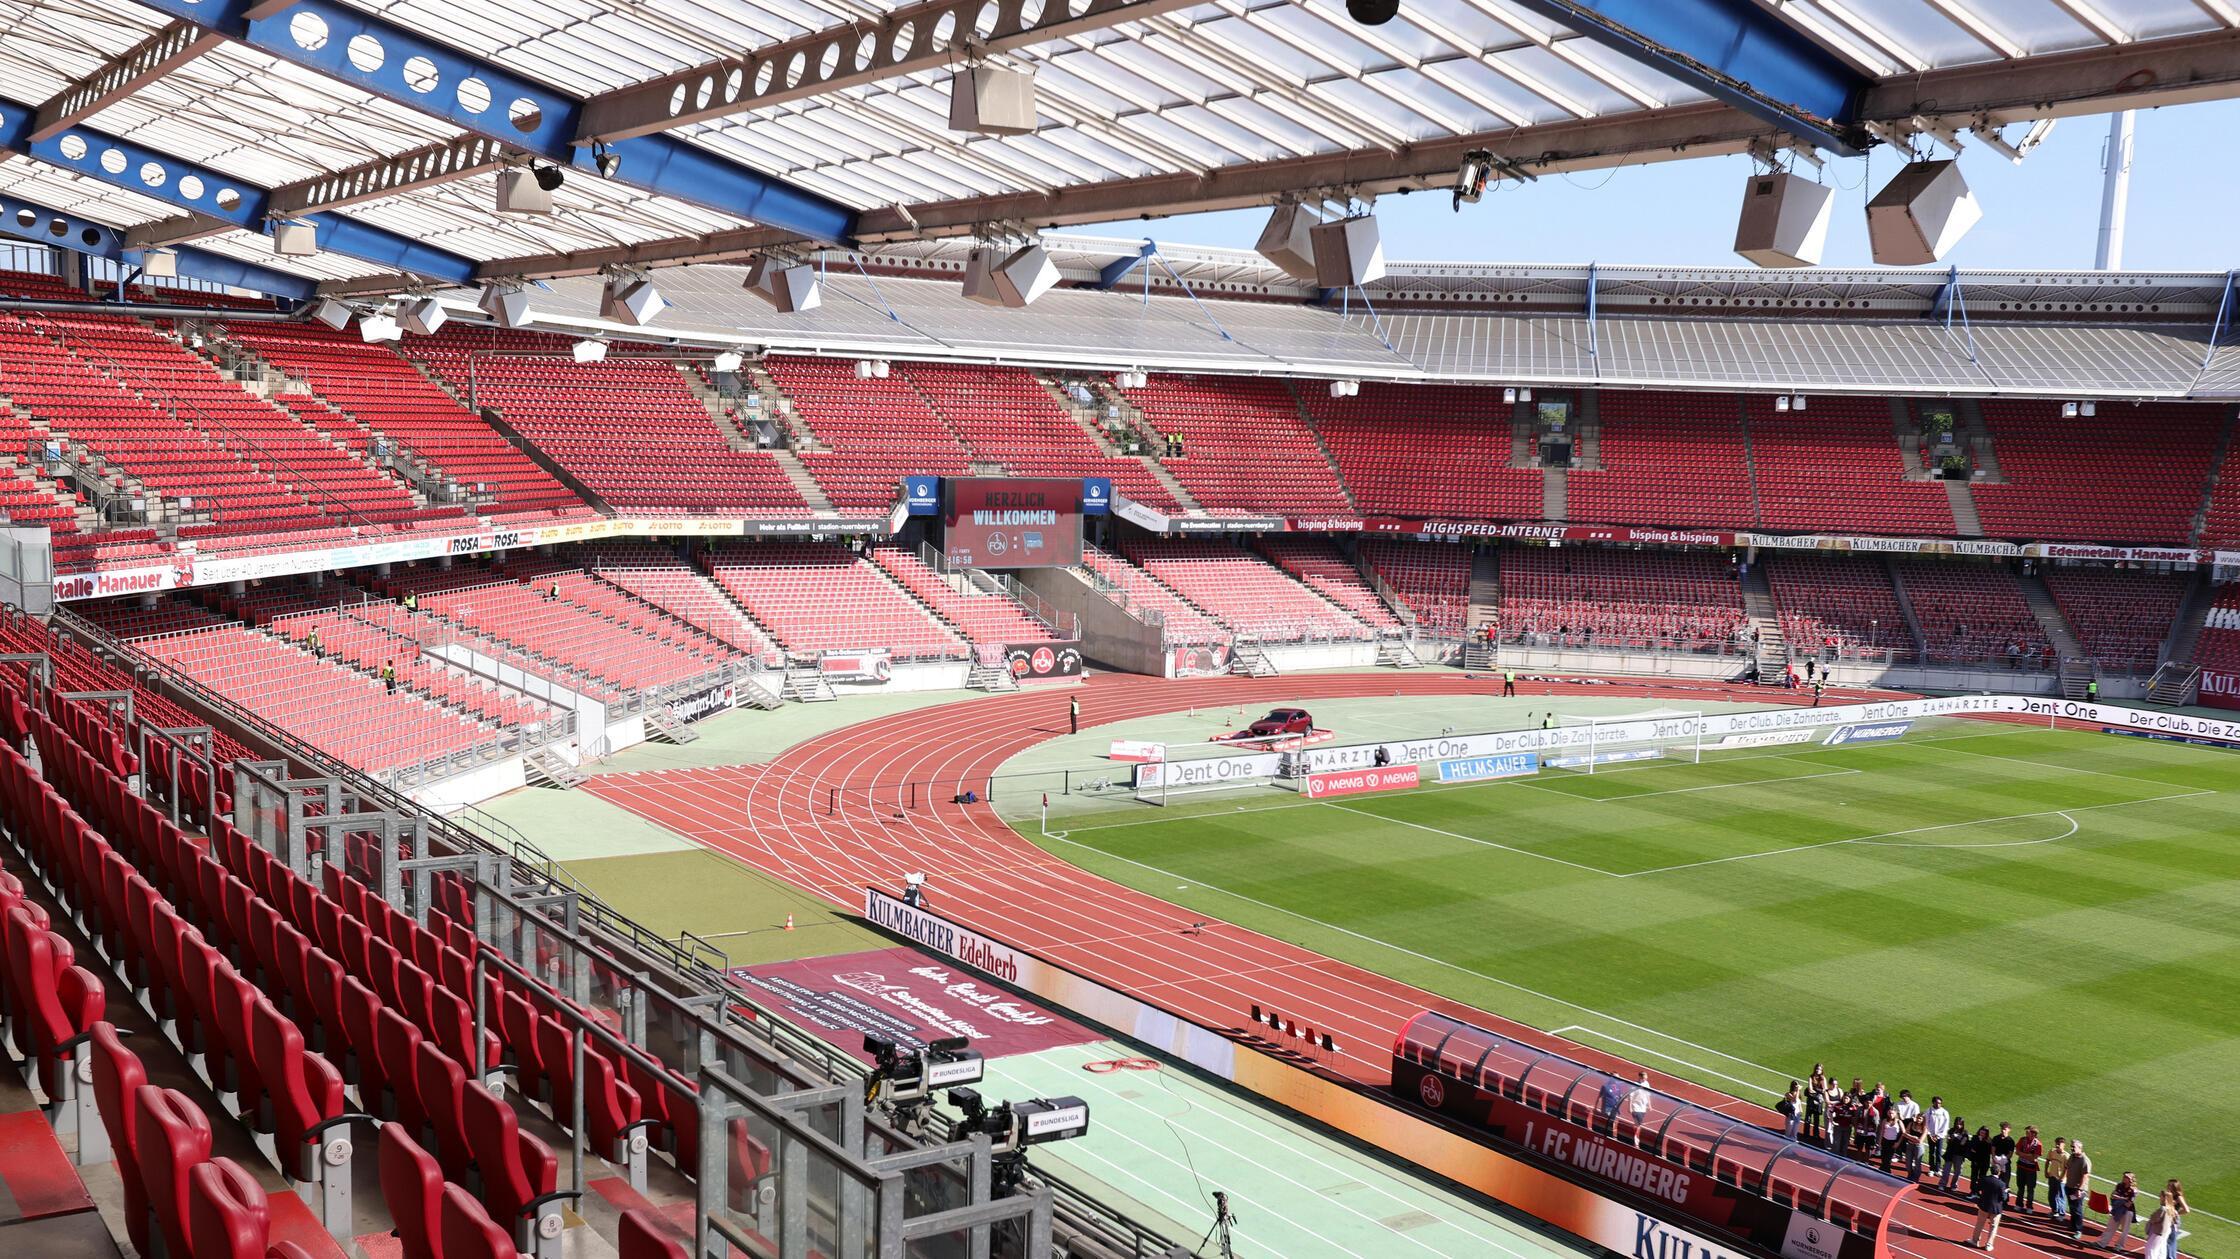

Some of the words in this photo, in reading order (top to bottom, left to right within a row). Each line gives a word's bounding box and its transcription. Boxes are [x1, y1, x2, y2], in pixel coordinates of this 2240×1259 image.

[985, 492, 1045, 507] HERZLICH
[973, 510, 1056, 525] WILLKOMMEN
[1298, 519, 1327, 531] bisping
[1335, 519, 1363, 531] bisping
[659, 522, 682, 530] LOTTO
[709, 522, 732, 530] LOTTO
[1422, 522, 1568, 538] HIGHSPEED-INTERNET
[494, 533, 519, 547] ROSA
[1630, 529, 1668, 542] bisping
[1670, 532, 1679, 541] &
[1680, 531, 1719, 544] bisping
[1751, 534, 1816, 548] KULMBACHER
[453, 537, 479, 552] ROSA
[989, 541, 1006, 550] FCN
[1853, 538, 1919, 551] KULMBACHER
[1956, 541, 2023, 556] KULMBACHER
[2131, 548, 2191, 561] Hanauer
[98, 572, 162, 595] Hanauer
[2200, 671, 2240, 695] KUL
[1887, 703, 1909, 718] One
[1923, 698, 1999, 713] ZAHNÄRZTE
[2065, 702, 2098, 719] One
[1730, 717, 1748, 730] Der
[1750, 715, 1773, 729] Club.
[1776, 713, 1791, 726] Die
[1793, 711, 1842, 725] Zahnärzte.
[2130, 712, 2153, 726] Der
[2157, 716, 2193, 732] Club.
[2198, 721, 2220, 735] Die
[1438, 740, 1469, 758] One
[1496, 737, 1516, 751] Der
[1518, 732, 1548, 749] Club.
[1551, 732, 1568, 746] Die
[1217, 759, 1253, 777] One
[1450, 756, 1529, 778] HELMSAUER
[869, 890, 954, 955] KULMBACHER
[958, 934, 1018, 983] Edelherb
[939, 1066, 976, 1077] BUNDESLIGA
[1423, 1085, 1442, 1103] FCN
[1040, 1114, 1079, 1126] BUNDESLIGA
[1523, 1121, 1537, 1151] 1.
[1542, 1128, 1570, 1162] FC
[1572, 1134, 1691, 1204] NÜRNBERG
